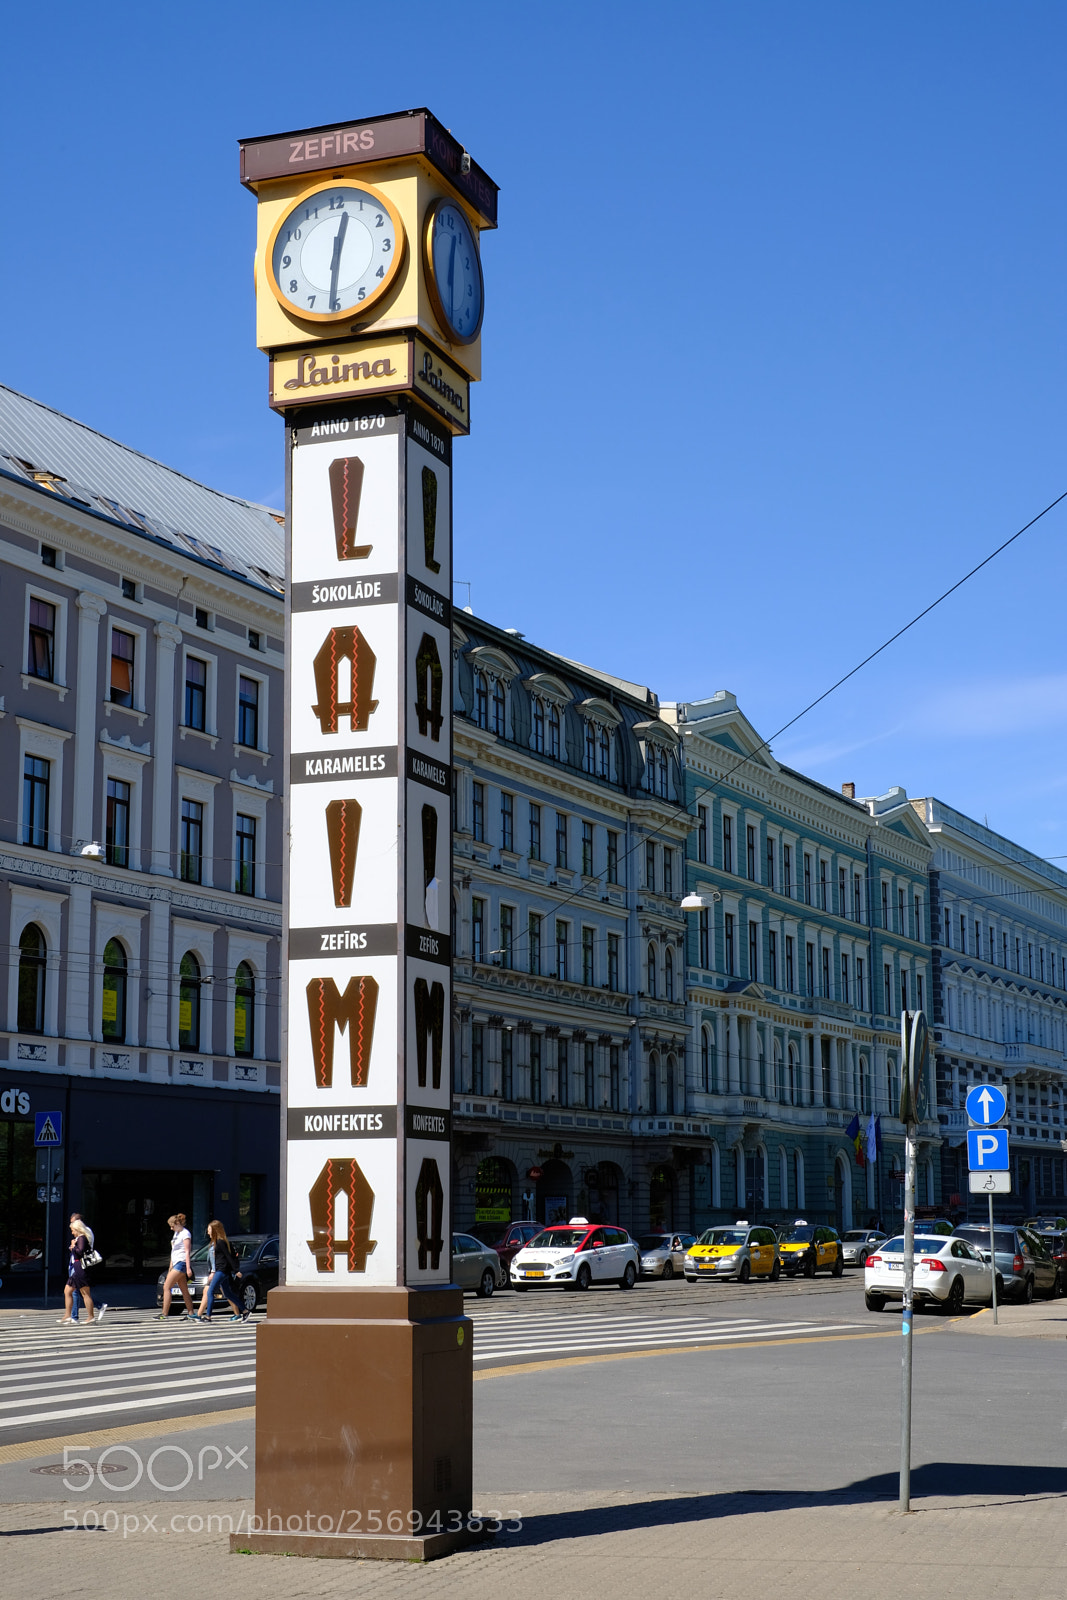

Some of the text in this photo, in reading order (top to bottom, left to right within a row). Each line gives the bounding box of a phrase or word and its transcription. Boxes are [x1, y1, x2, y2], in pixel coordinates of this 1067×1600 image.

[288, 129, 375, 163] ZEFĪRS
[432, 129, 491, 208] KONKTES
[328, 195, 345, 211] 12
[359, 199, 364, 211] 1
[305, 207, 319, 221] 11
[375, 214, 384, 228] 2
[447, 214, 454, 230] 12
[286, 228, 301, 243] 10
[382, 238, 391, 252] 3
[282, 255, 291, 269] 9
[465, 257, 470, 271] 2
[375, 265, 385, 279] 4
[289, 279, 298, 293] 8
[358, 287, 366, 301] 5
[468, 284, 472, 297] 3
[307, 295, 316, 309] 7
[332, 298, 341, 312] 6
[284, 354, 397, 391] Laima
[418, 352, 465, 413] Laima
[311, 414, 385, 437] ANNO 1870
[413, 419, 444, 455] ANNO 1870
[312, 581, 381, 604] ŠOKOLĀDE
[414, 585, 444, 618] ŠOKOLĀDE
[305, 754, 386, 776] KARAMELES
[412, 757, 446, 786] KARAMELES
[320, 930, 368, 951] ZEFĪRS
[419, 935, 439, 956] ZEFĪRS
[304, 1113, 383, 1132] KONFEKTES
[412, 1114, 445, 1133] KONFEKTES
[977, 1135, 999, 1165] P
